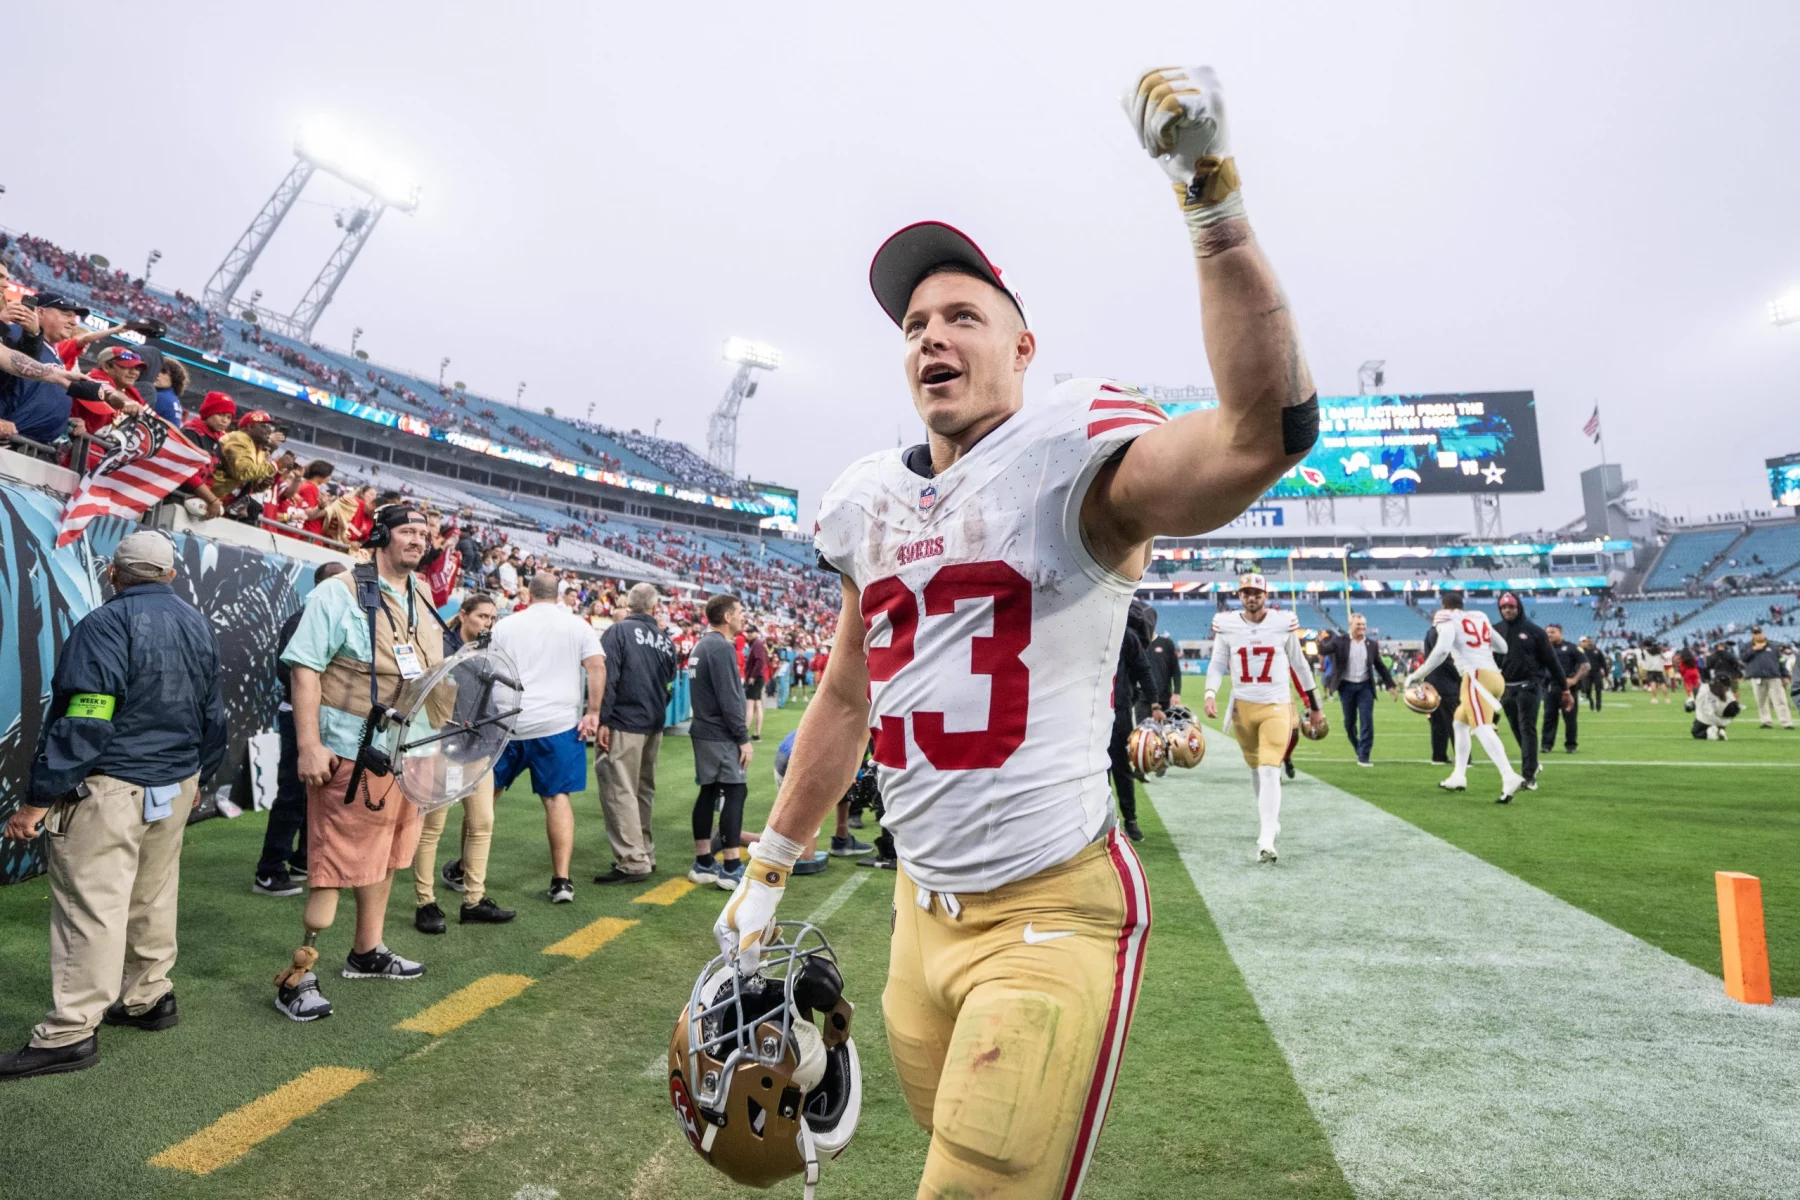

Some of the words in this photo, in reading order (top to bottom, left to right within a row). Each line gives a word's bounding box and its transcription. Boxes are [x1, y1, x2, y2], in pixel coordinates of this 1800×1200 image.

[84, 315, 109, 331] 4TH
[1153, 384, 1217, 399] EverBan
[1367, 405, 1415, 417] ACTION
[1417, 403, 1456, 416] FROM
[1457, 402, 1485, 415] THE
[1423, 415, 1460, 429] DECK
[897, 536, 944, 566] 49ERS
[1461, 618, 1491, 650] 94
[861, 560, 1032, 770] 23
[1237, 647, 1275, 683] 17
[80, 697, 99, 705] WEEK
